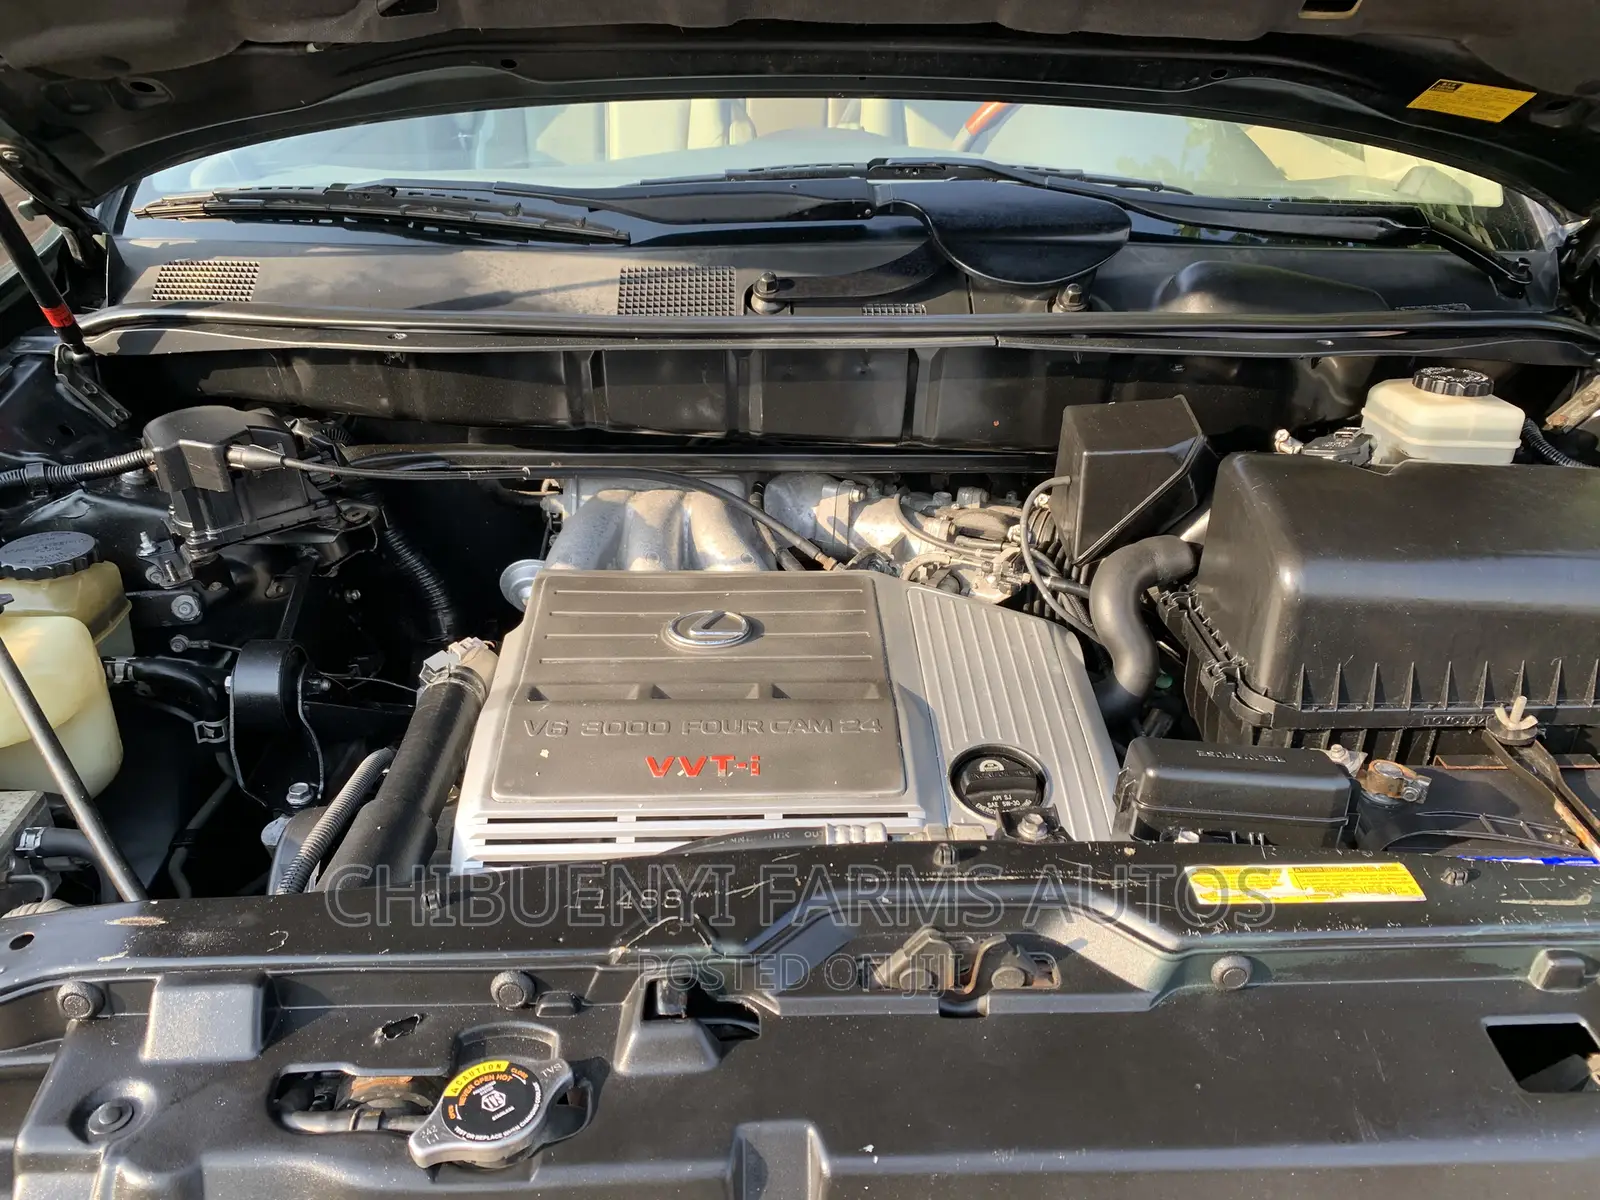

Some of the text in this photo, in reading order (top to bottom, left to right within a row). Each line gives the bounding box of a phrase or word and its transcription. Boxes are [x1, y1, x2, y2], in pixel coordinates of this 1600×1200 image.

[523, 717, 882, 737] V6 3000 FOUR CAM 24
[644, 755, 761, 778] VVT-i
[455, 1063, 502, 1086] CAUTION
[473, 1074, 495, 1087] OPEN
[496, 1073, 514, 1082] HOT
[466, 1132, 475, 1140] OR
[474, 1132, 504, 1141] REPLACE
